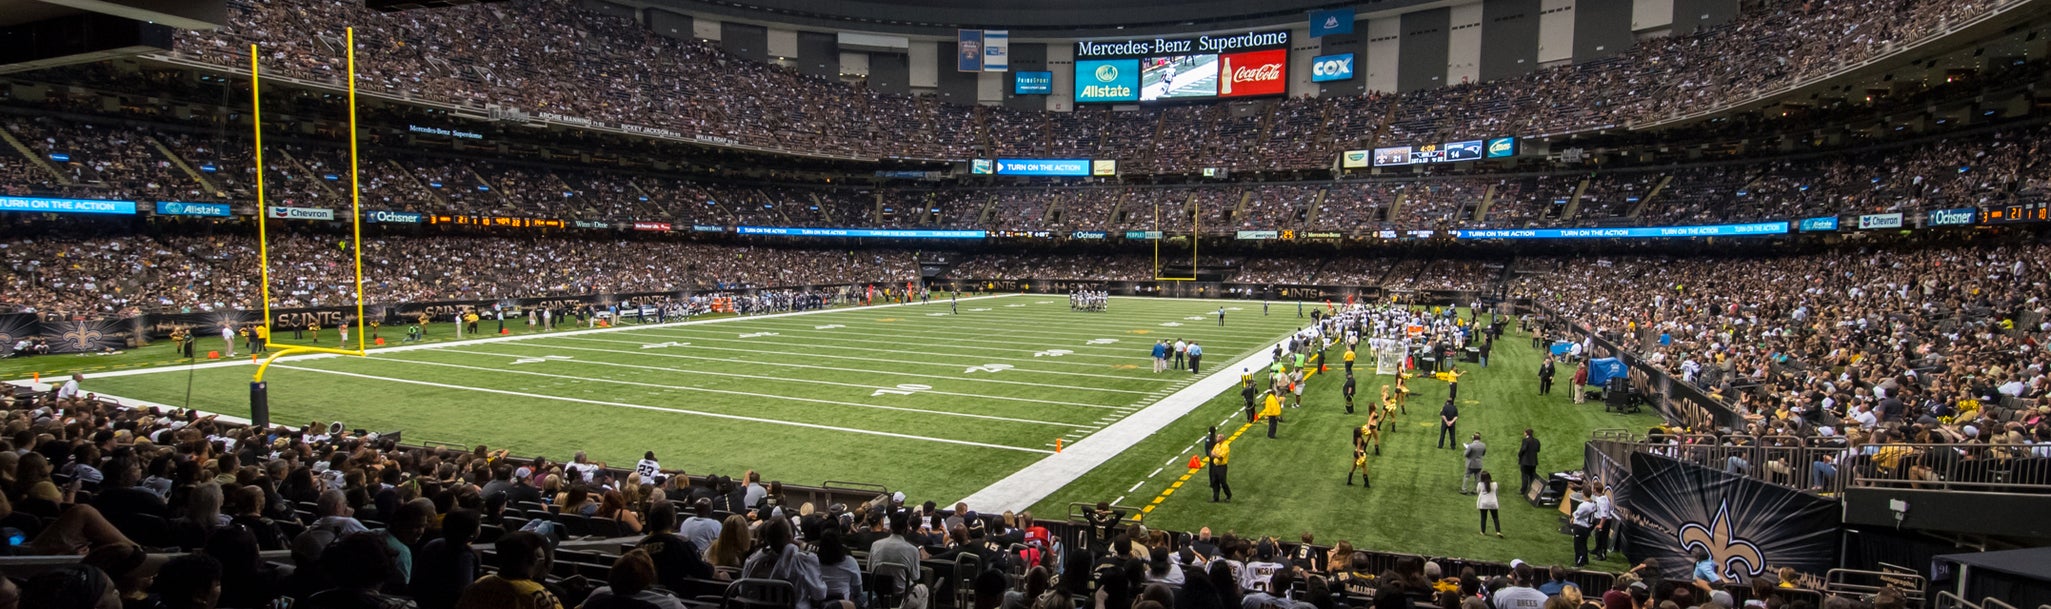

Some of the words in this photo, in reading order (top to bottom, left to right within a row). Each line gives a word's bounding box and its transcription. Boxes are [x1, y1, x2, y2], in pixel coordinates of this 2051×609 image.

[1078, 38, 1191, 57] Mercedes-Benz
[1199, 31, 1287, 53] Superdome
[1233, 63, 1283, 83] Coca-Cola
[1313, 58, 1352, 77] COX
[1080, 84, 1130, 97] Allstate
[539, 112, 562, 121] ARCHIE
[563, 115, 592, 125] MANNING
[1393, 155, 1402, 163] 21
[0, 199, 29, 208] TURN
[31, 200, 49, 209] ON
[51, 201, 73, 210] THE
[75, 202, 116, 211] ACTION
[183, 205, 221, 216] Allstate
[291, 209, 328, 218] Chevron
[377, 211, 418, 223] Ochsner
[1935, 210, 1973, 224] Ochsner
[1983, 211, 1988, 223] 3
[2011, 208, 2022, 219] 21
[2038, 208, 2047, 220] 10
[1872, 216, 1898, 226] Chevron
[1076, 230, 1104, 239] Ochsner
[1283, 230, 1294, 239] 25
[638, 464, 654, 477] 23
[1255, 567, 1276, 576] INGRA
